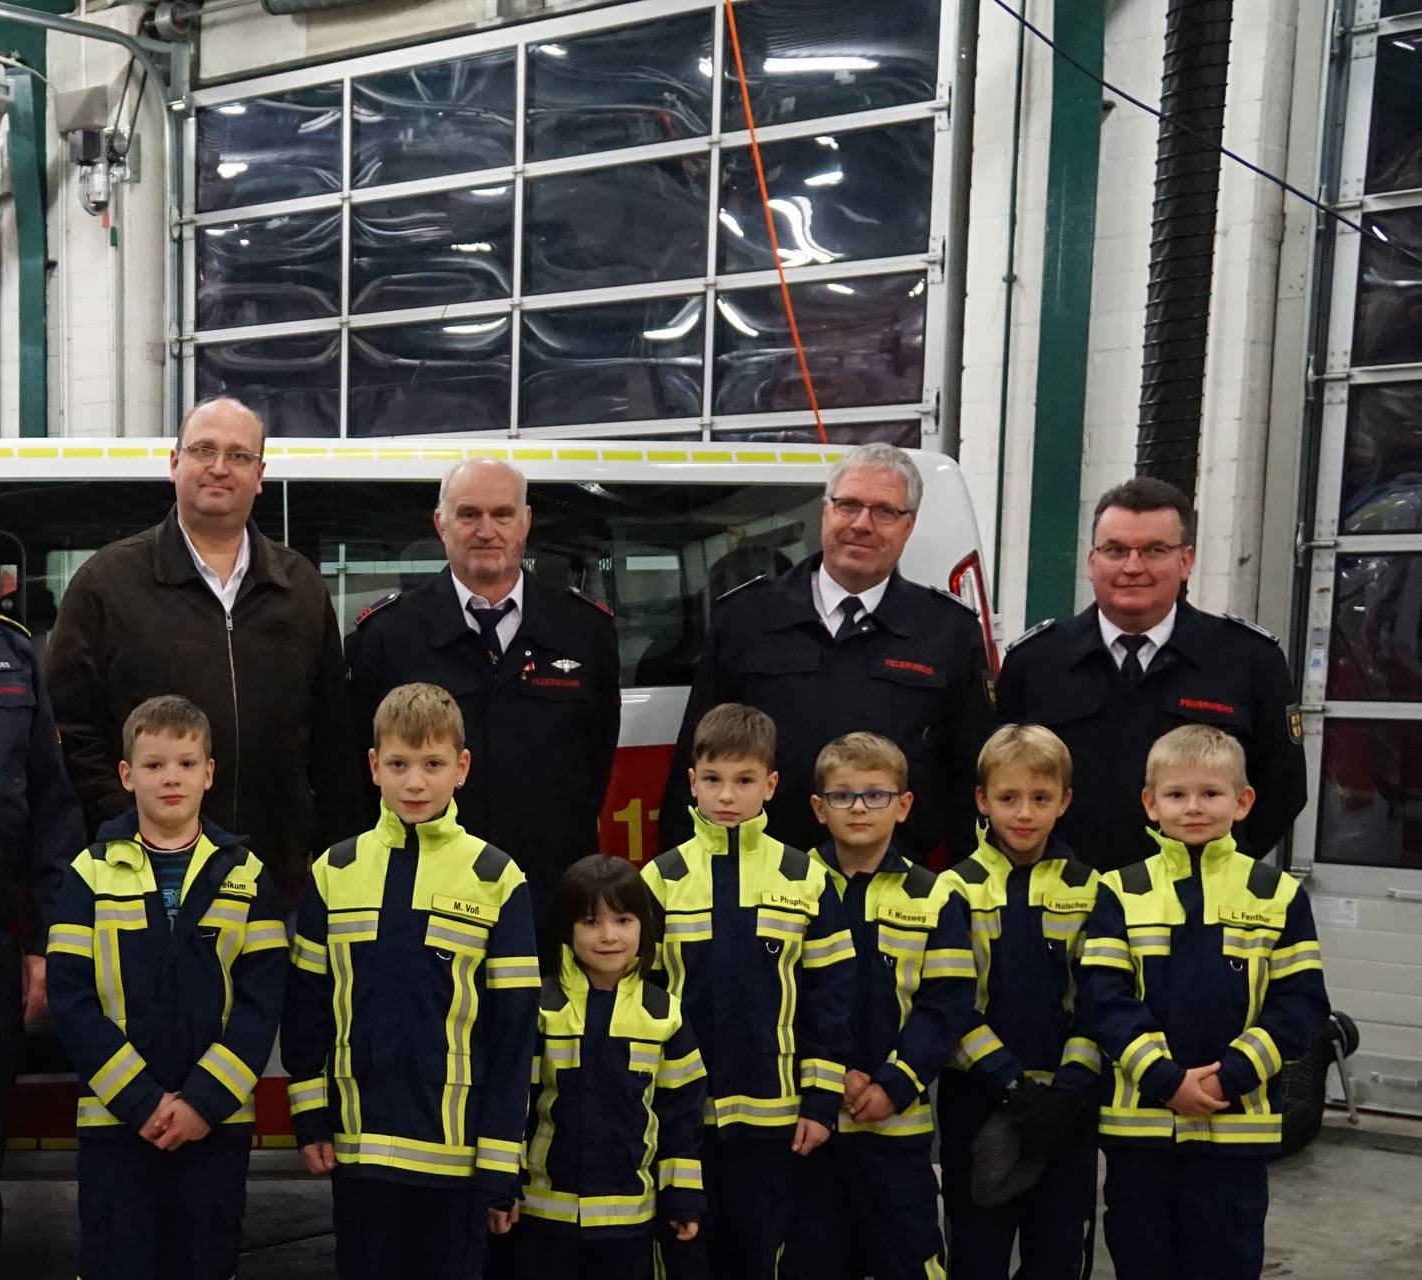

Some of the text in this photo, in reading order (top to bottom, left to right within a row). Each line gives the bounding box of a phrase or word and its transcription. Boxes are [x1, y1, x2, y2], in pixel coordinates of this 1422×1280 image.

[453, 901, 480, 915] M. Voß
[895, 911, 928, 924] Wiesweg
